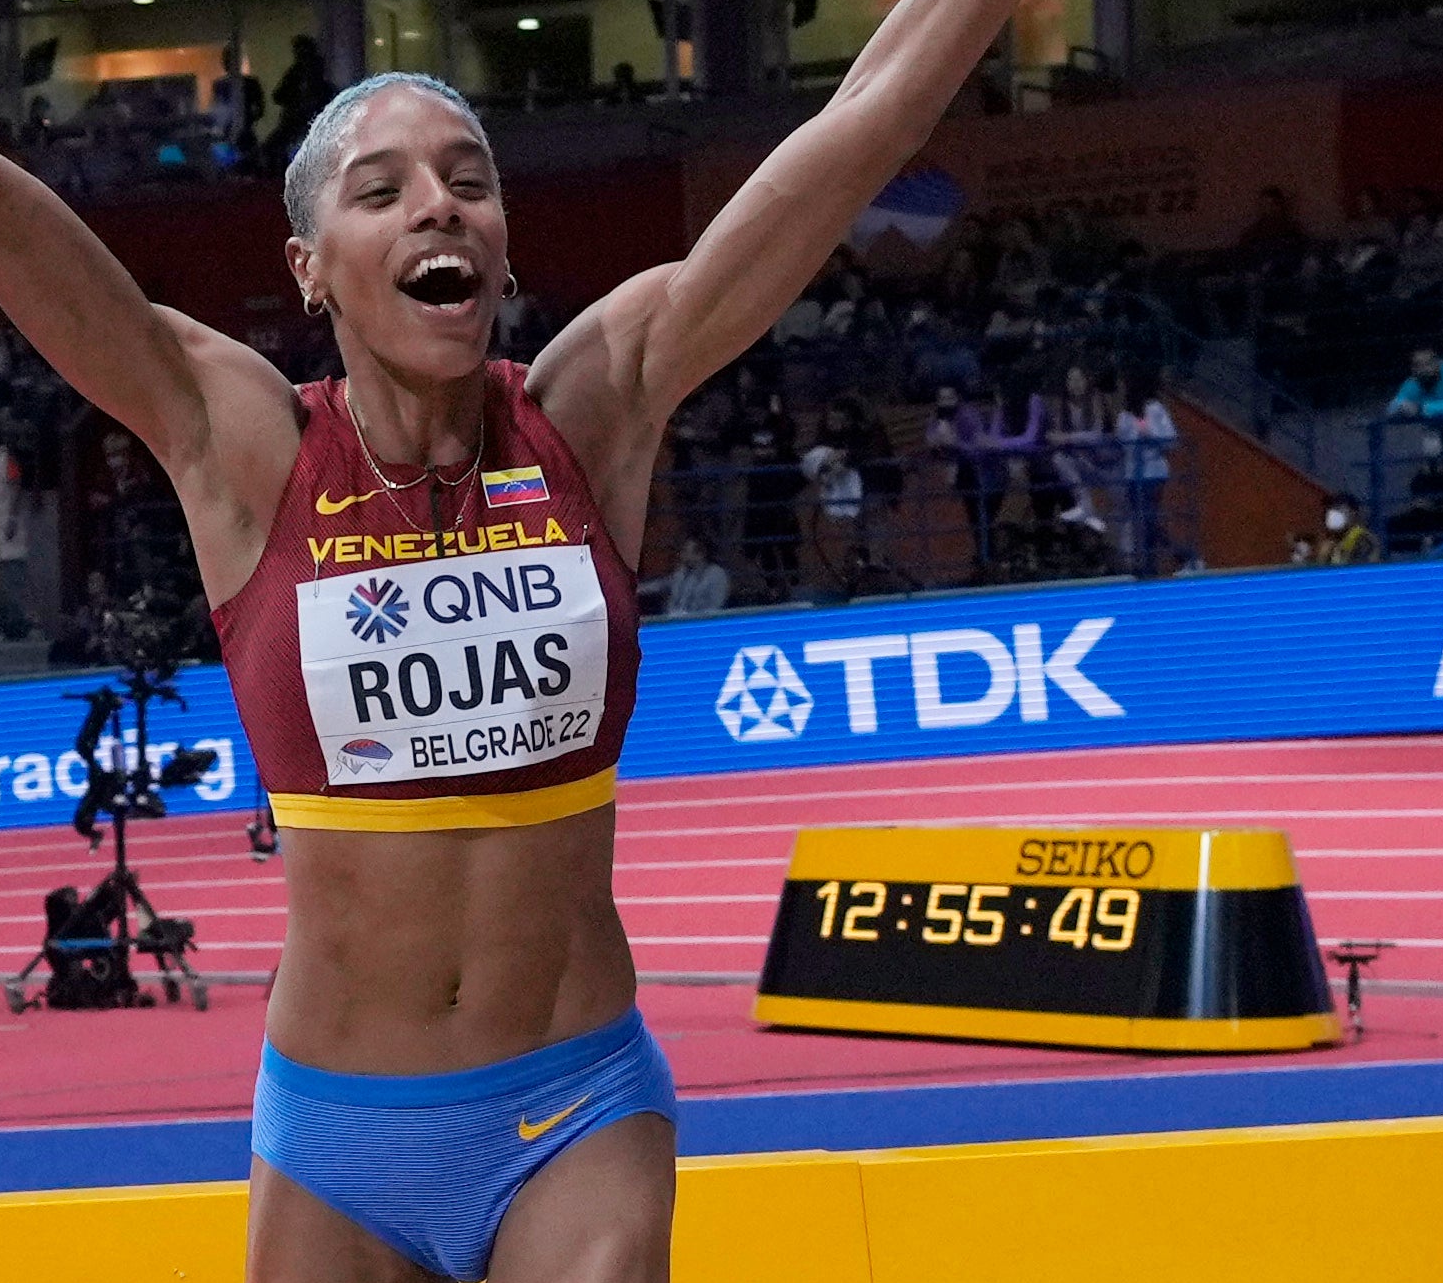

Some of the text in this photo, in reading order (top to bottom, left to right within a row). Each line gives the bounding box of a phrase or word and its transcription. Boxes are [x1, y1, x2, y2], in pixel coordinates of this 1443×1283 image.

[307, 518, 568, 563] VENEZUELA
[424, 564, 562, 624] QNB
[348, 633, 571, 723] ROJAS
[803, 616, 1127, 734] TDK
[411, 709, 592, 768] BELGRADE 22
[1017, 839, 1154, 879] SEIKO
[816, 881, 1142, 952] 12:55:49
